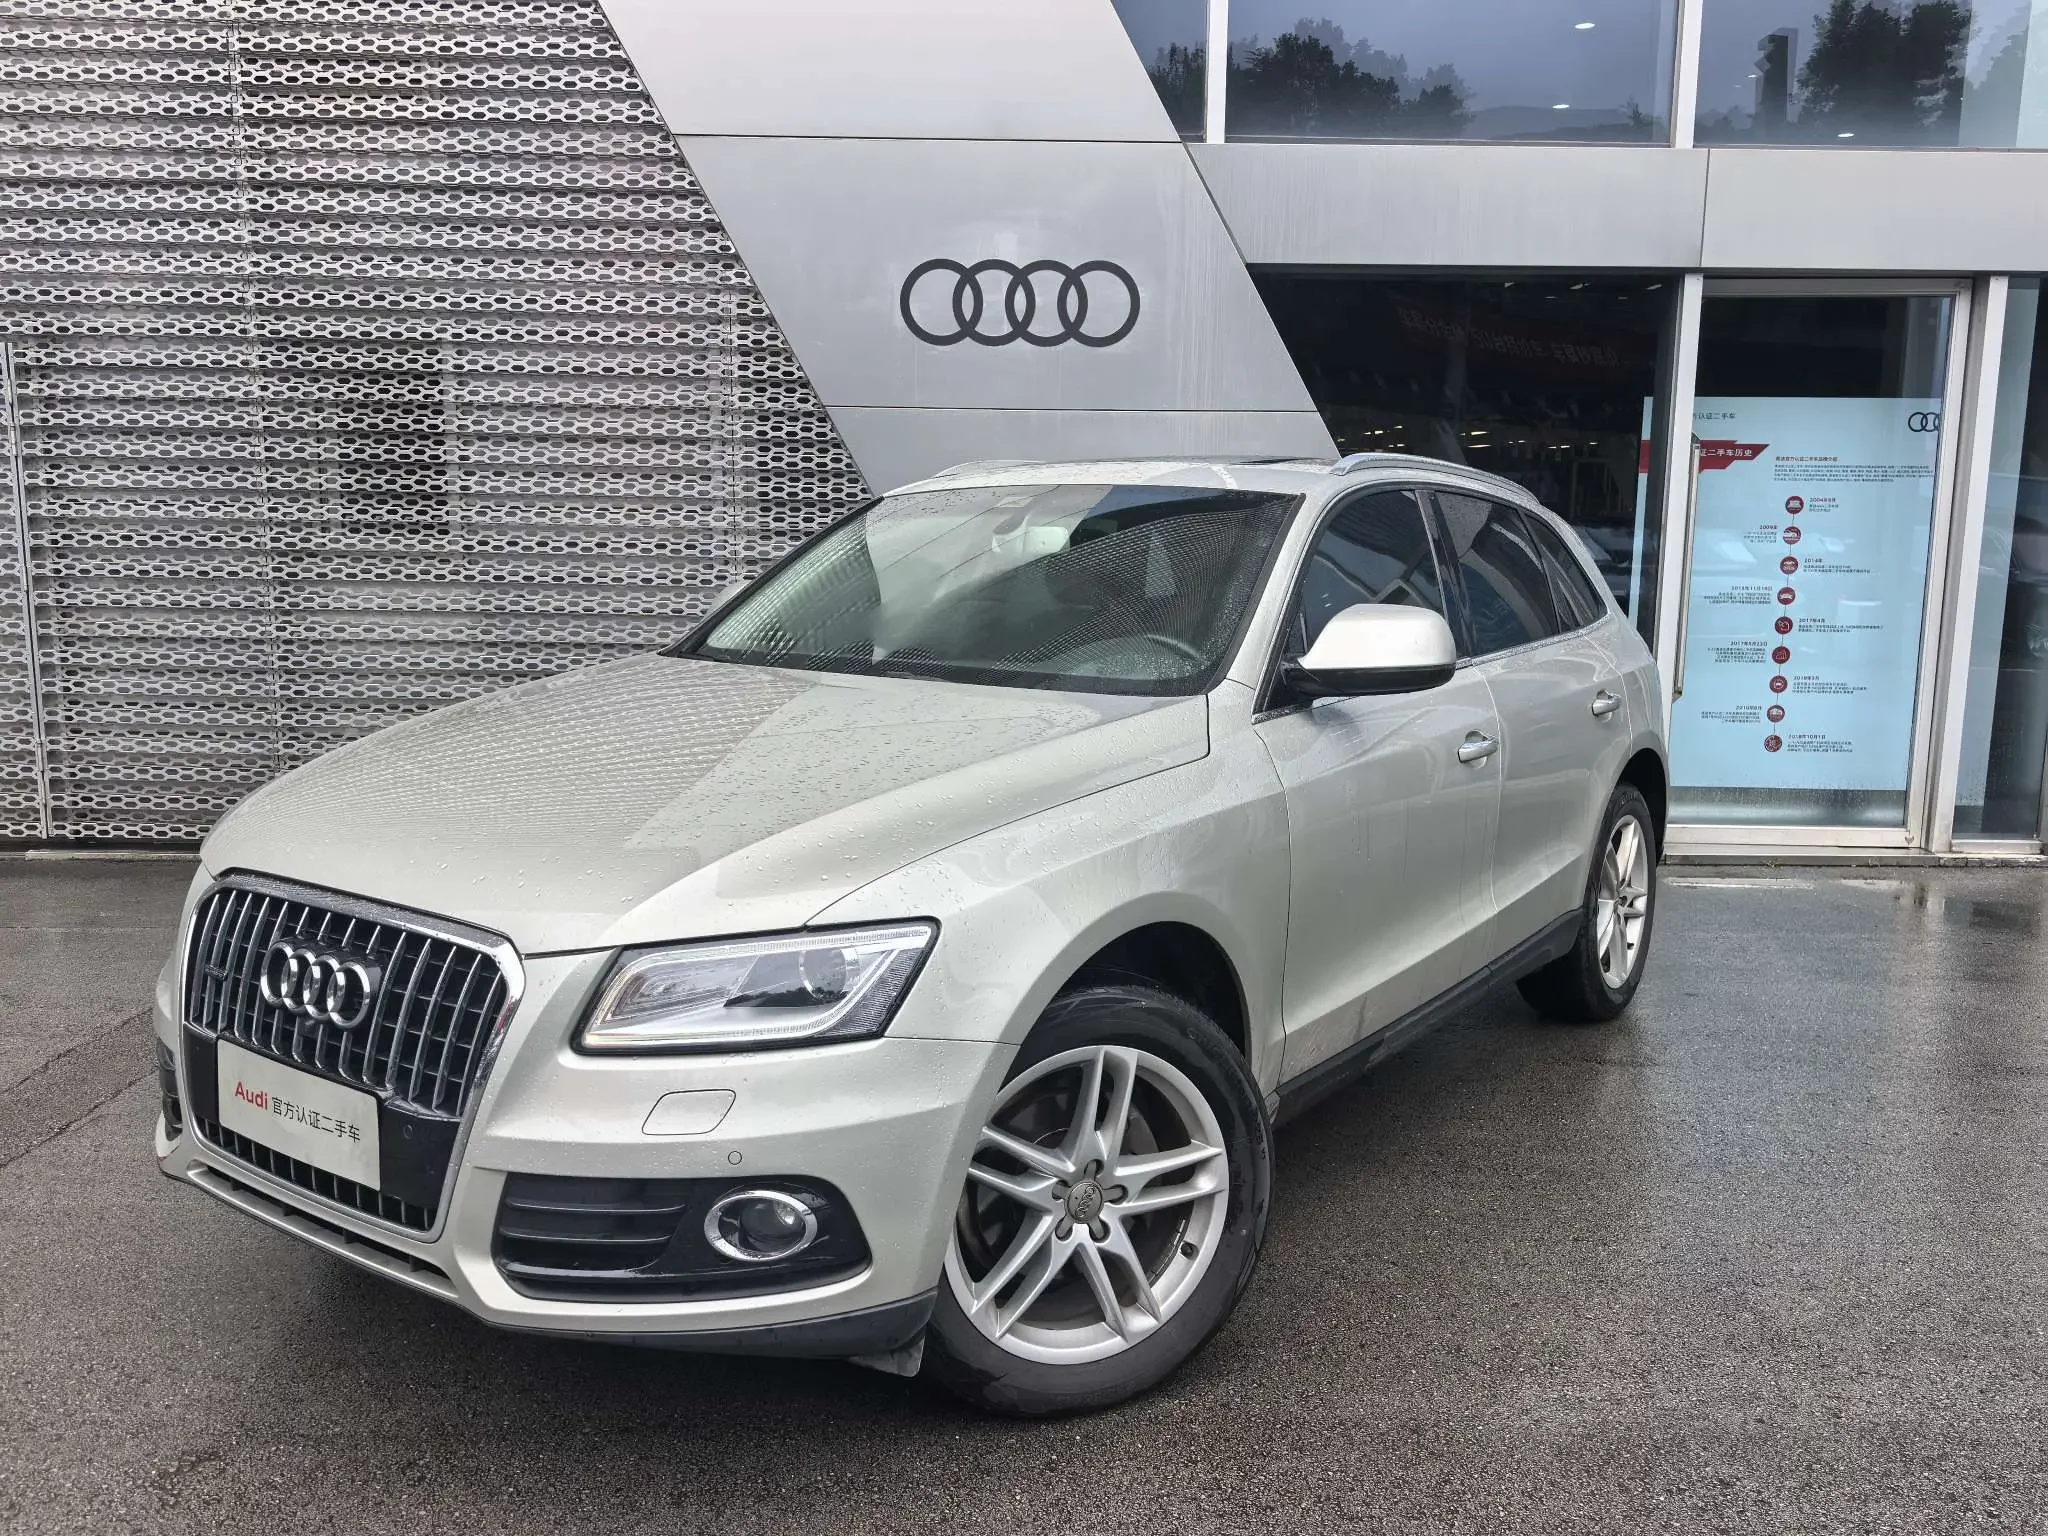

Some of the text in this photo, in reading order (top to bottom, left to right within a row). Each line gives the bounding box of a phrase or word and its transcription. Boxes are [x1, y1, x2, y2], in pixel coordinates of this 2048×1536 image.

[234, 1081, 361, 1143] Audi 官方认证二手车
